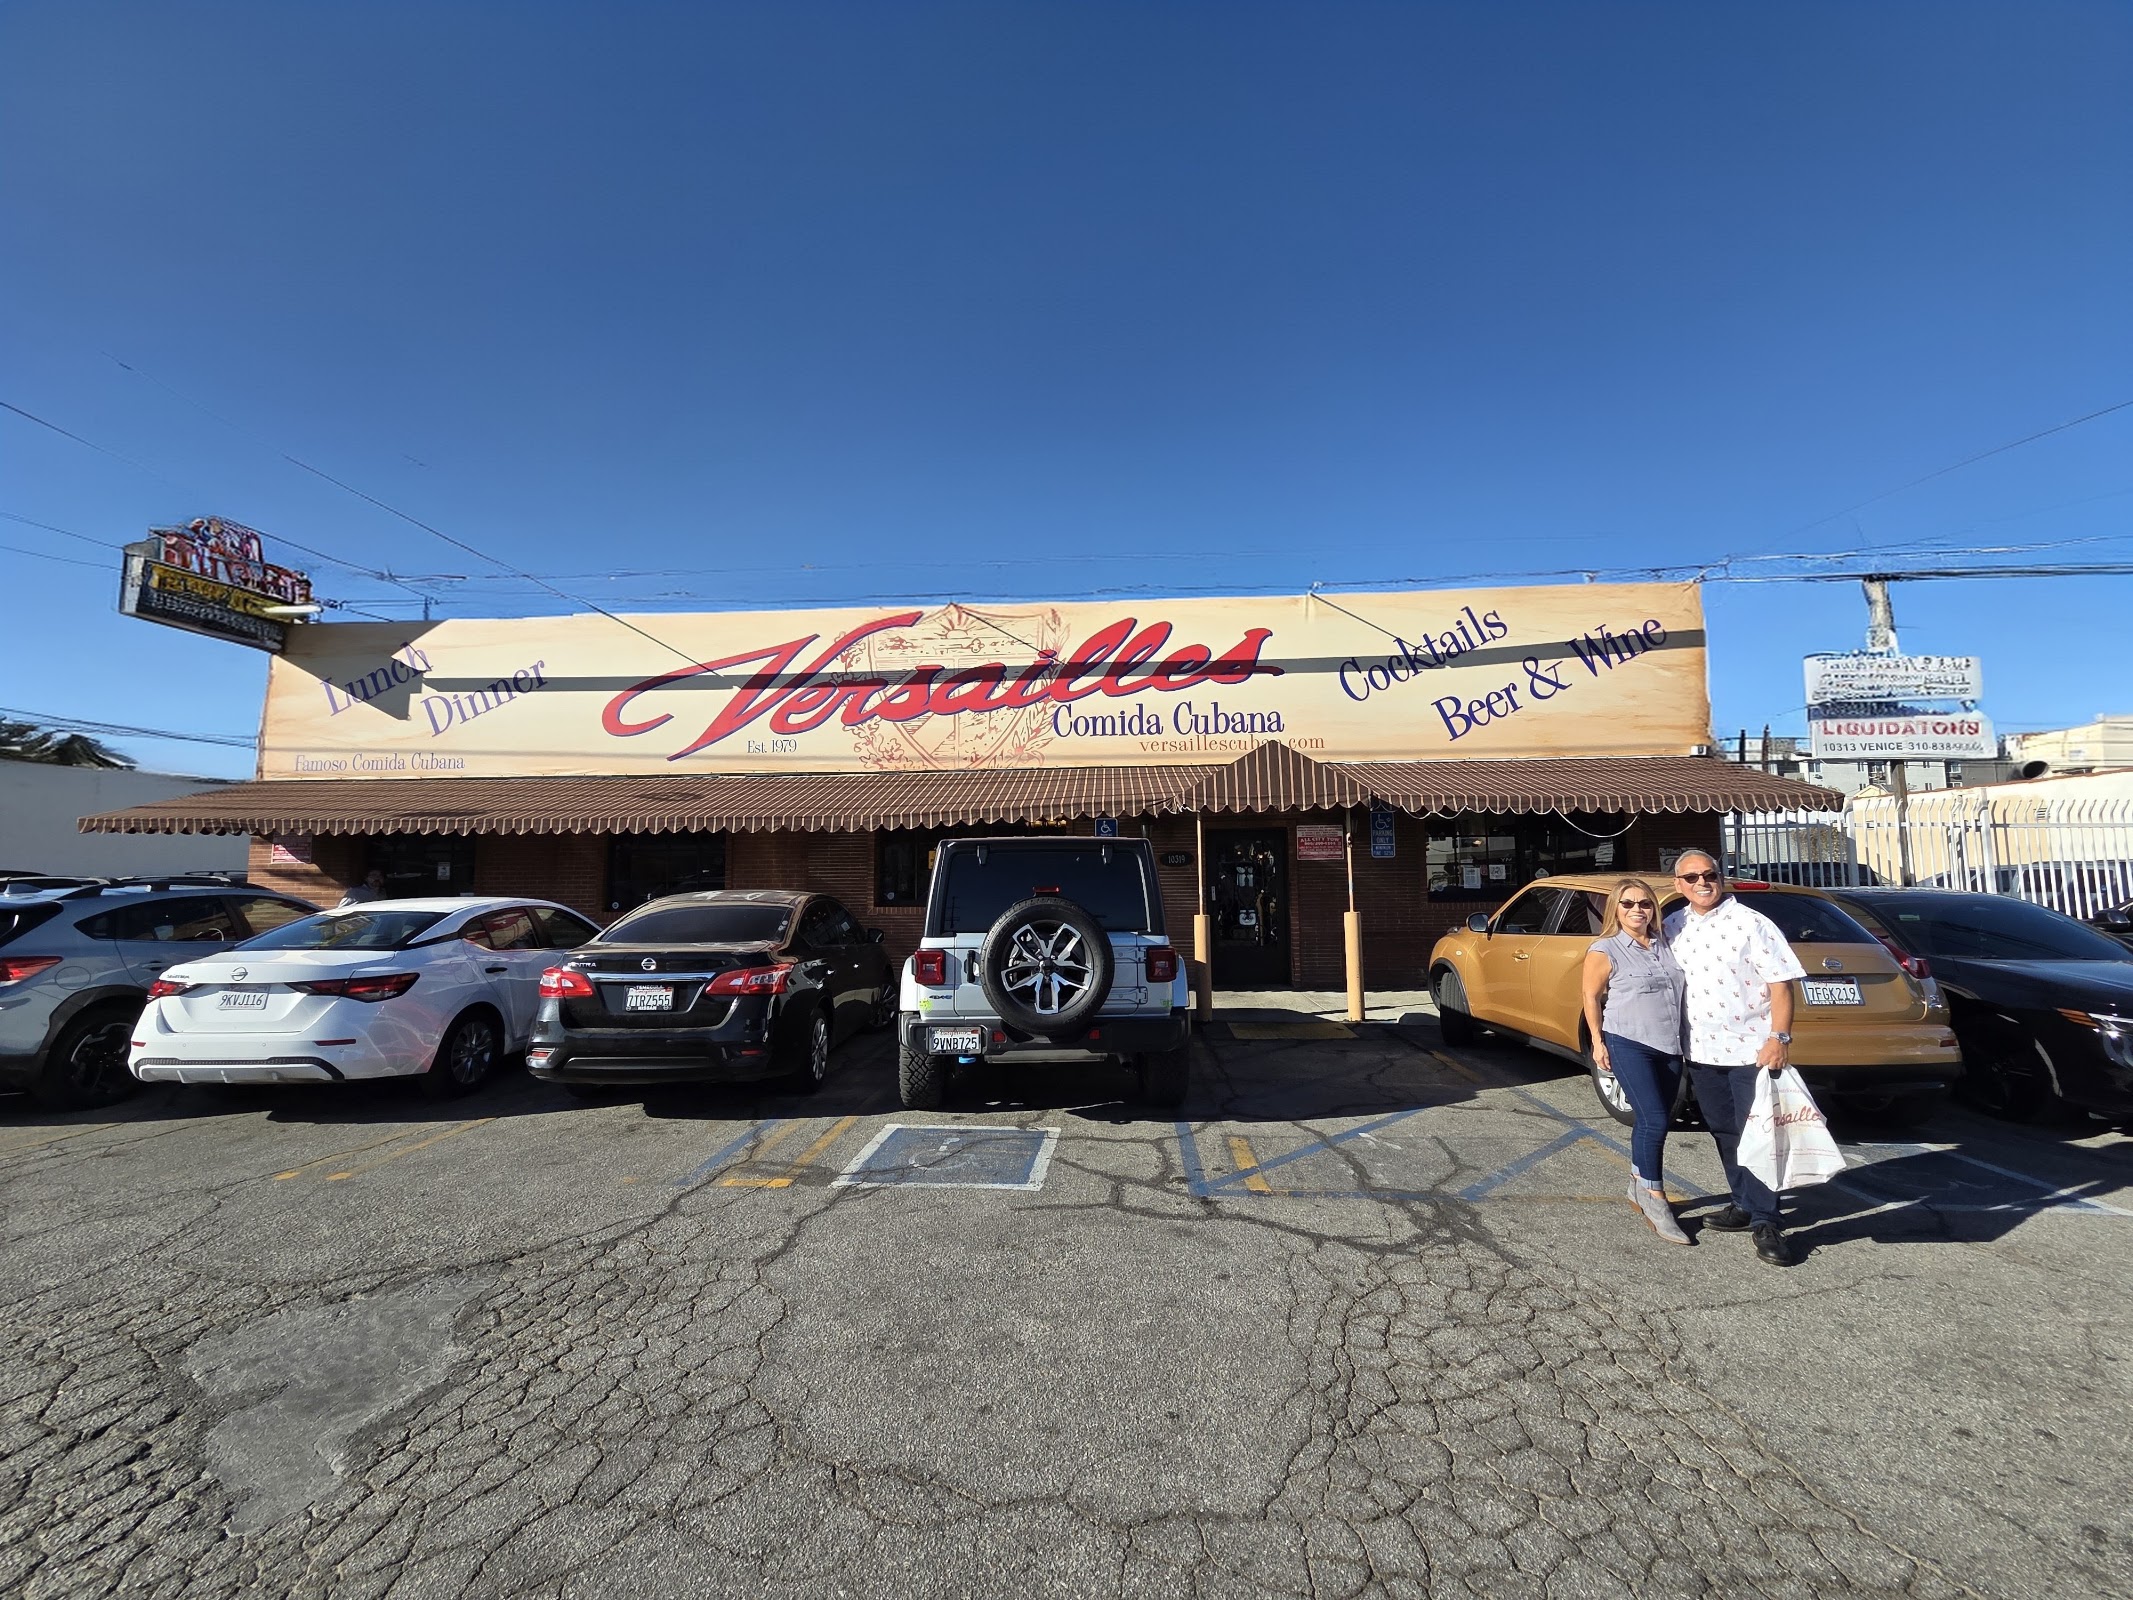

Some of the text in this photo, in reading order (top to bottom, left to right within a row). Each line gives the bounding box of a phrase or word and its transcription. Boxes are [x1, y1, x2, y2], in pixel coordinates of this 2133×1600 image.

[1339, 606, 1508, 702] Cocktails
[320, 642, 433, 716] Lunch
[602, 612, 1285, 760] Versailles
[1431, 618, 1667, 741] Beer & Wine
[421, 660, 548, 737] Dinner
[1053, 702, 1285, 739] Comida Cubana
[747, 738, 798, 755] Est. 1979
[1139, 734, 1325, 752] versaillescubcom
[1823, 743, 1856, 752] 10313
[1860, 742, 1903, 751] VENICE
[294, 751, 465, 772] Famoso Comida Cubana
[219, 994, 265, 1006] 9KVJ116
[628, 994, 671, 1006] 7TRZ555
[1808, 987, 1856, 1003] 7FGK219
[933, 1037, 978, 1050] 9VNB725
